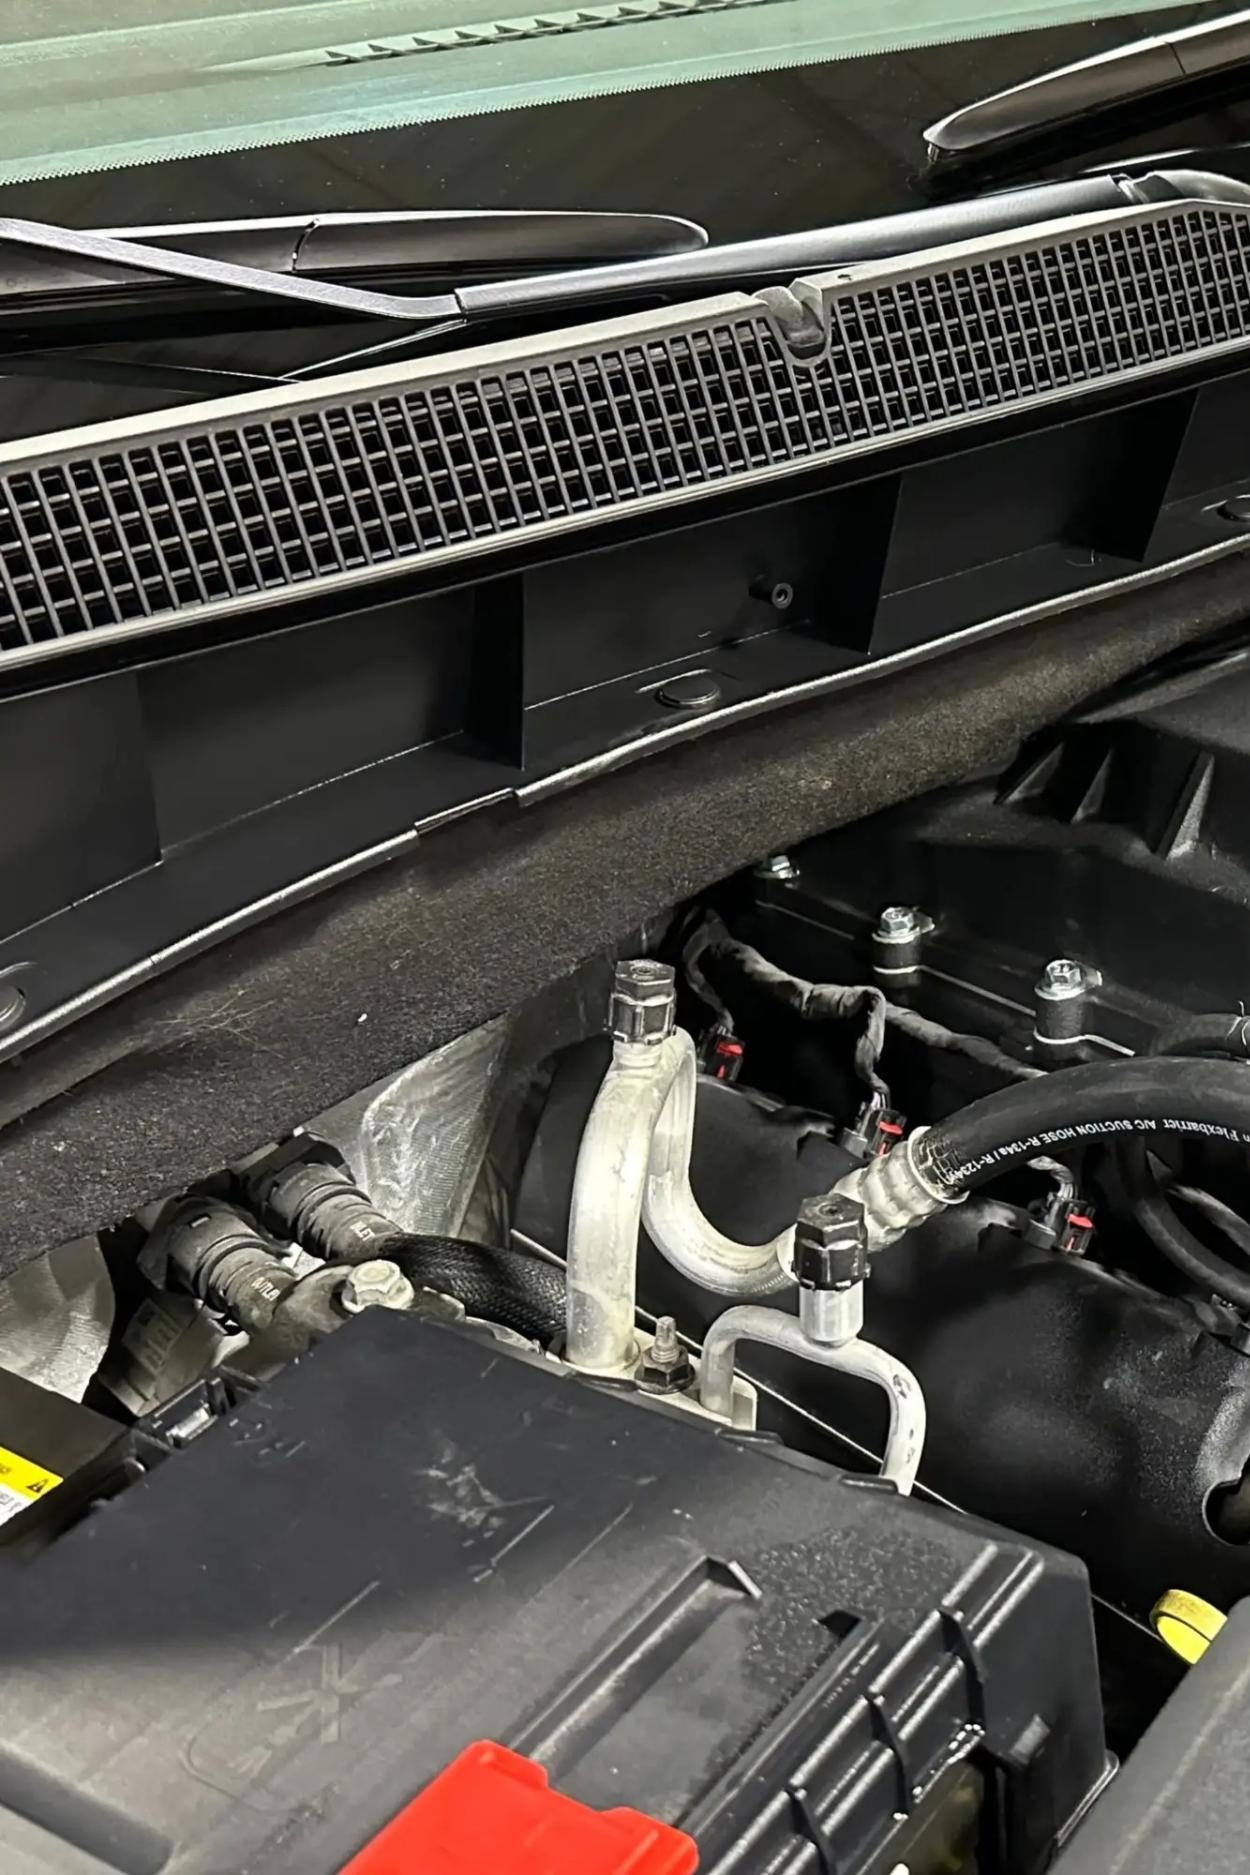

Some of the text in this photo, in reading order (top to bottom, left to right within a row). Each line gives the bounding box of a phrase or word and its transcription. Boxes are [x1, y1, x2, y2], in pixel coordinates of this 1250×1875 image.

[1076, 1119, 1134, 1136] SUCTION
[1134, 1118, 1156, 1130] A/C
[1163, 1118, 1240, 1142] Flexbarrier
[1040, 1131, 1077, 1144] HOSE
[1000, 1137, 1040, 1156] R-134a
